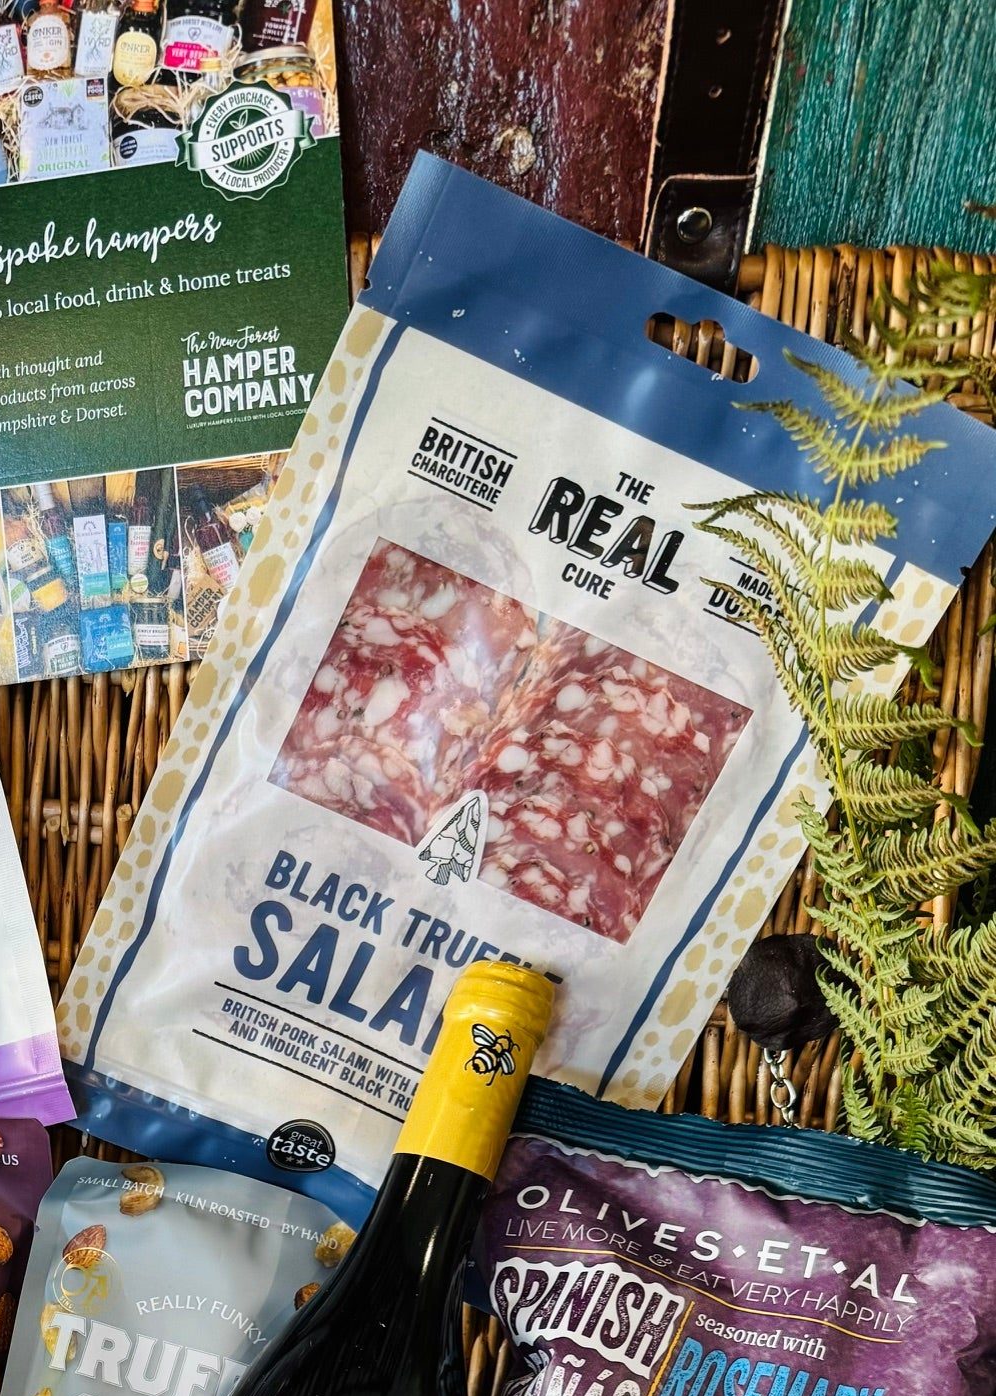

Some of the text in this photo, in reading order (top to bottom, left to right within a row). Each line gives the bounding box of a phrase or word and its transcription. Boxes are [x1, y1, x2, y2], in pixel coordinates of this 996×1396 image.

[206, 92, 274, 129] EVERY PURCHASE
[211, 119, 285, 162] SUPPORTS
[218, 148, 289, 188] A LOCAL PRODUCER
[85, 213, 222, 263] hampers
[7, 295, 50, 318] local
[54, 288, 101, 311] food,
[105, 281, 155, 303] drink
[159, 278, 175, 295] &
[178, 270, 231, 291] home
[236, 261, 291, 284] treats
[181, 326, 280, 354] The New Forest
[50, 382, 86, 404] from
[90, 375, 136, 393] across
[183, 346, 296, 387] HAMPER
[61, 410, 72, 424] &
[76, 402, 127, 421] Dorset.
[185, 374, 315, 417] COMPANY
[208, 418, 232, 426] HAMPERS
[411, 452, 502, 504] CHARCUTERIE
[418, 426, 513, 486] BRITISH
[529, 476, 690, 595] REAL
[265, 851, 395, 938] BLACK
[222, 998, 412, 1092] BRITISH PORK SALAMI WITH
[229, 1021, 385, 1098] AND INDULGENT BLACK
[506, 1218, 557, 1240] LIVE
[561, 1223, 640, 1256] MORE
[676, 1262, 728, 1290] EAT
[730, 1278, 805, 1308] VERY
[805, 1290, 913, 1334] HAPPILY
[136, 1296, 268, 1347] REALLY FUNKY
[494, 1262, 678, 1367] SPANISH
[695, 1311, 827, 1362] seasoned with
